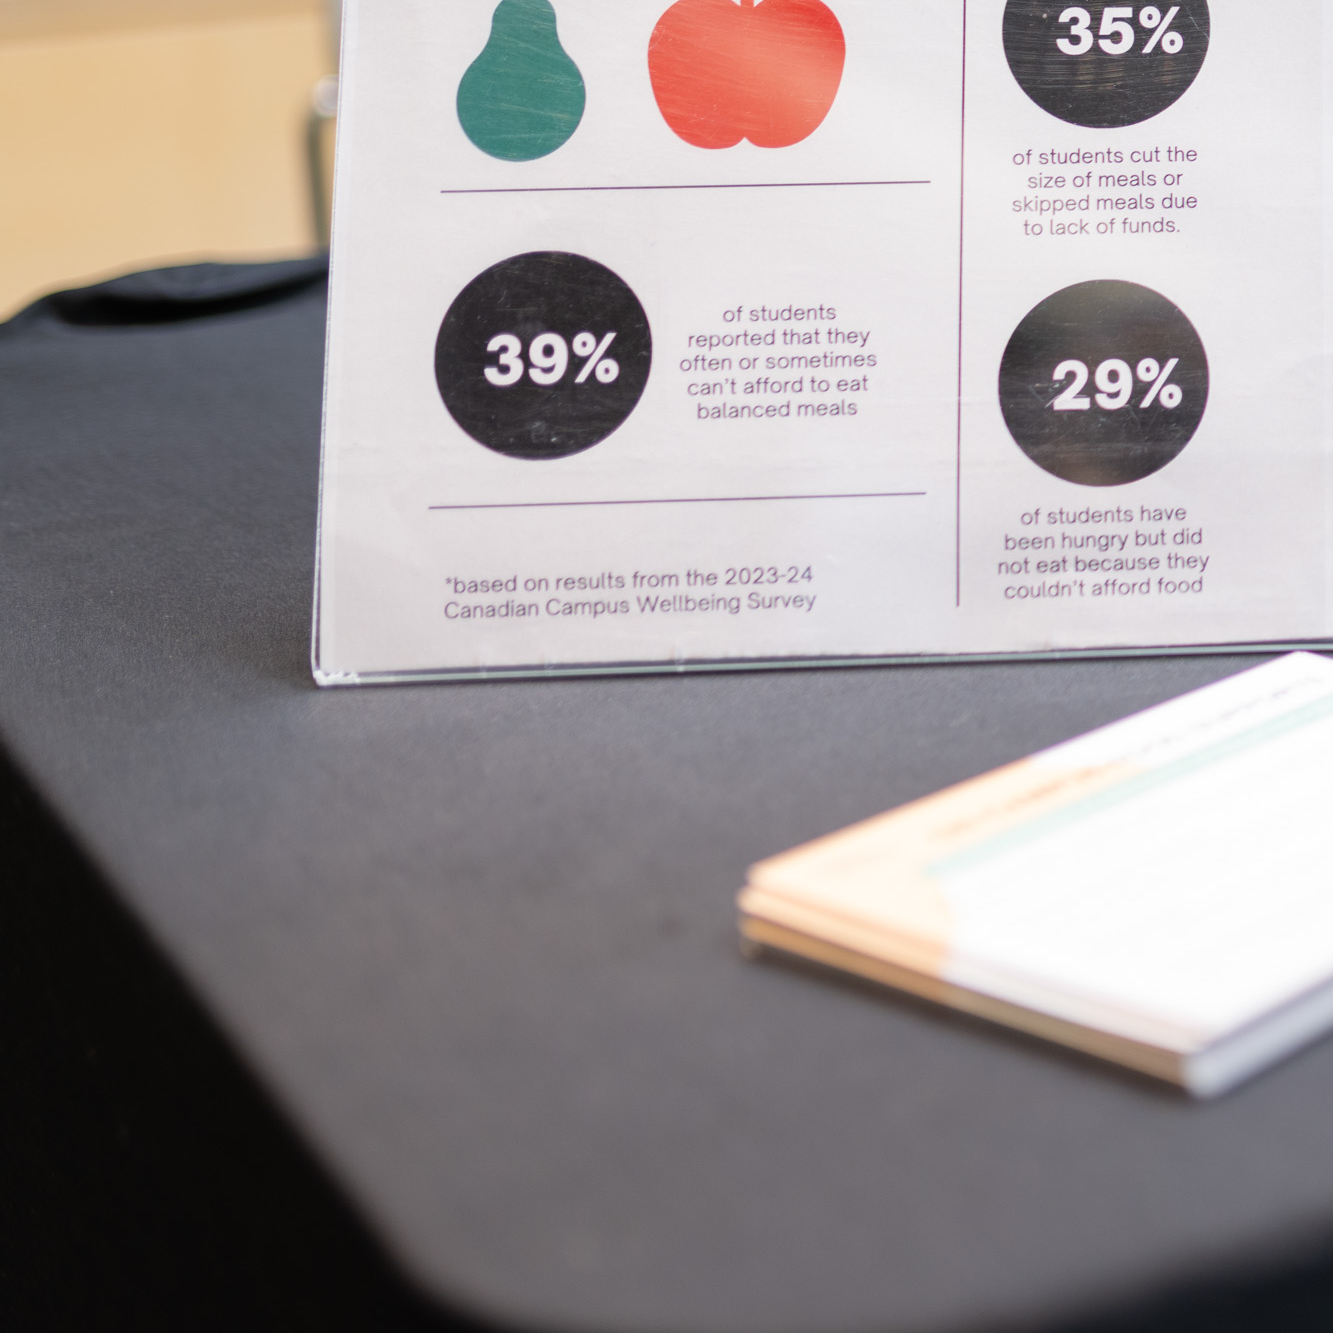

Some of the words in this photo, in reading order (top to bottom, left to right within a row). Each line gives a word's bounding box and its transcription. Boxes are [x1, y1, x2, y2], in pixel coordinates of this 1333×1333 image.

[1055, 5, 1184, 56] 35%
[1012, 148, 1033, 166] of
[1038, 147, 1124, 165] students
[1129, 146, 1161, 163] cut
[1166, 145, 1198, 163] the
[1027, 172, 1067, 189] size
[1072, 171, 1093, 188] of
[1098, 170, 1157, 187] meals
[1163, 173, 1184, 187] or
[1012, 193, 1090, 216] skipped
[1096, 193, 1156, 211] meals
[1161, 192, 1198, 210] due
[1023, 219, 1044, 236] to
[1049, 218, 1090, 236] lack
[1095, 217, 1116, 235] of
[1121, 216, 1181, 234] funds.
[722, 305, 743, 323] of
[749, 303, 837, 322] students
[688, 329, 776, 352] reported
[781, 328, 821, 346] that
[826, 327, 871, 348] they
[483, 332, 620, 386] 39%
[679, 354, 732, 372] often
[738, 356, 760, 371] or
[765, 351, 878, 370] sometimes
[743, 376, 804, 395] afford
[809, 376, 831, 393] to
[836, 374, 868, 392] eat
[1051, 357, 1183, 411] 29%
[697, 400, 791, 420] balanced
[797, 398, 858, 417] meals
[1020, 507, 1041, 526] of
[1047, 505, 1134, 525] students
[1140, 505, 1187, 522] have
[1004, 533, 1056, 551] been
[1061, 531, 1129, 553] hungry
[1134, 529, 1167, 547] but
[1172, 527, 1203, 546] did
[997, 556, 1030, 575] not
[1035, 555, 1068, 574] eat
[1074, 555, 1161, 573] because
[1166, 552, 1210, 573] they
[523, 577, 549, 592] on
[555, 571, 626, 591] results
[632, 570, 680, 589] from
[685, 569, 719, 587] the
[724, 565, 813, 586] 2023-24
[1091, 577, 1151, 597] afford
[1157, 575, 1204, 594] food
[443, 599, 540, 620] Canadian
[545, 597, 630, 619] Campus
[636, 593, 741, 615] Wellbeing
[747, 591, 817, 613] Survey
